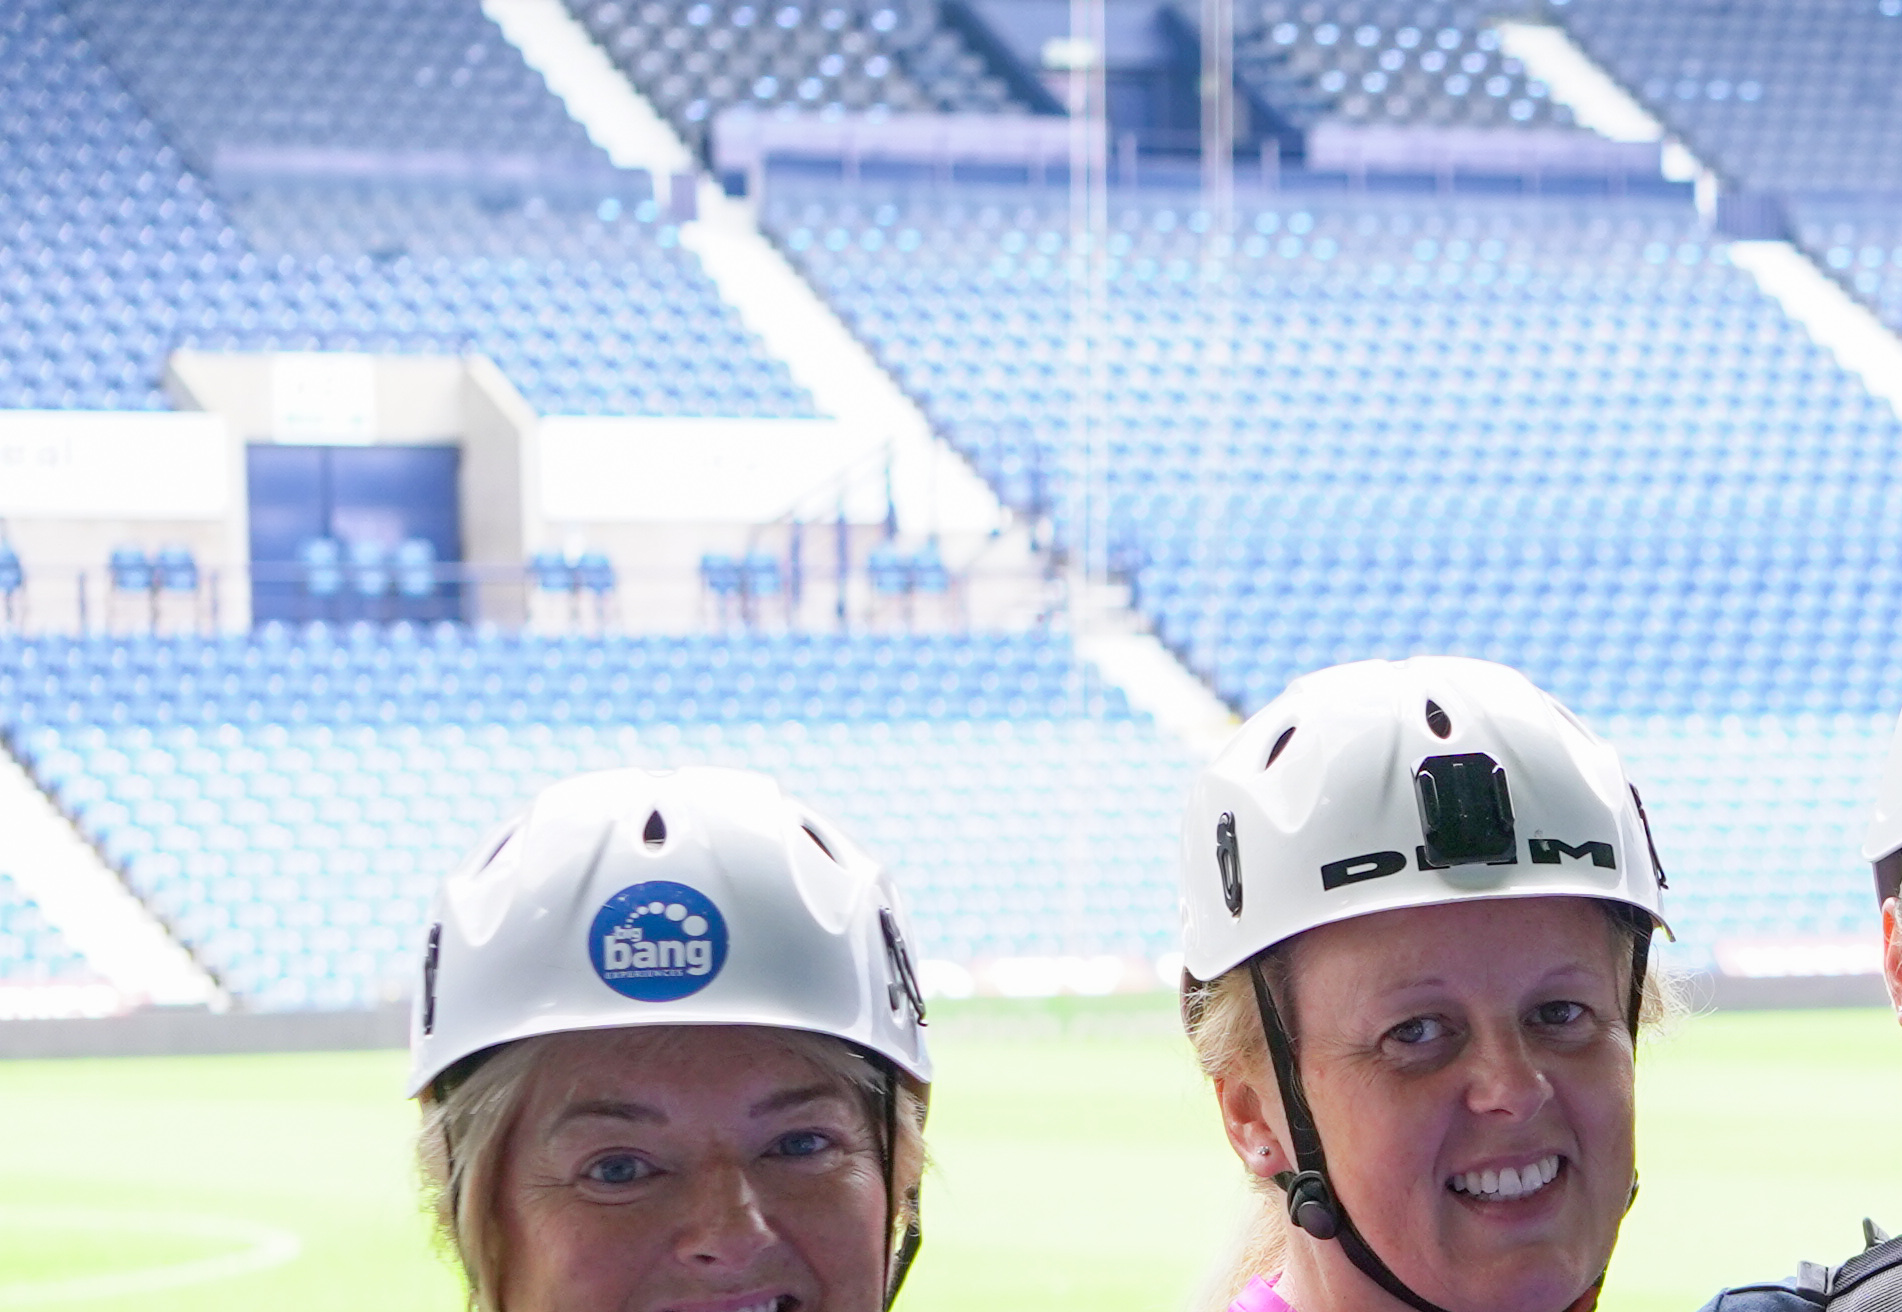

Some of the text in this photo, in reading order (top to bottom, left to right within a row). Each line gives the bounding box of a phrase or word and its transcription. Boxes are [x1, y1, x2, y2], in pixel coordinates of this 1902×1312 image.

[1321, 839, 1616, 891] DM
[613, 925, 643, 942] big
[603, 935, 713, 976] bang
